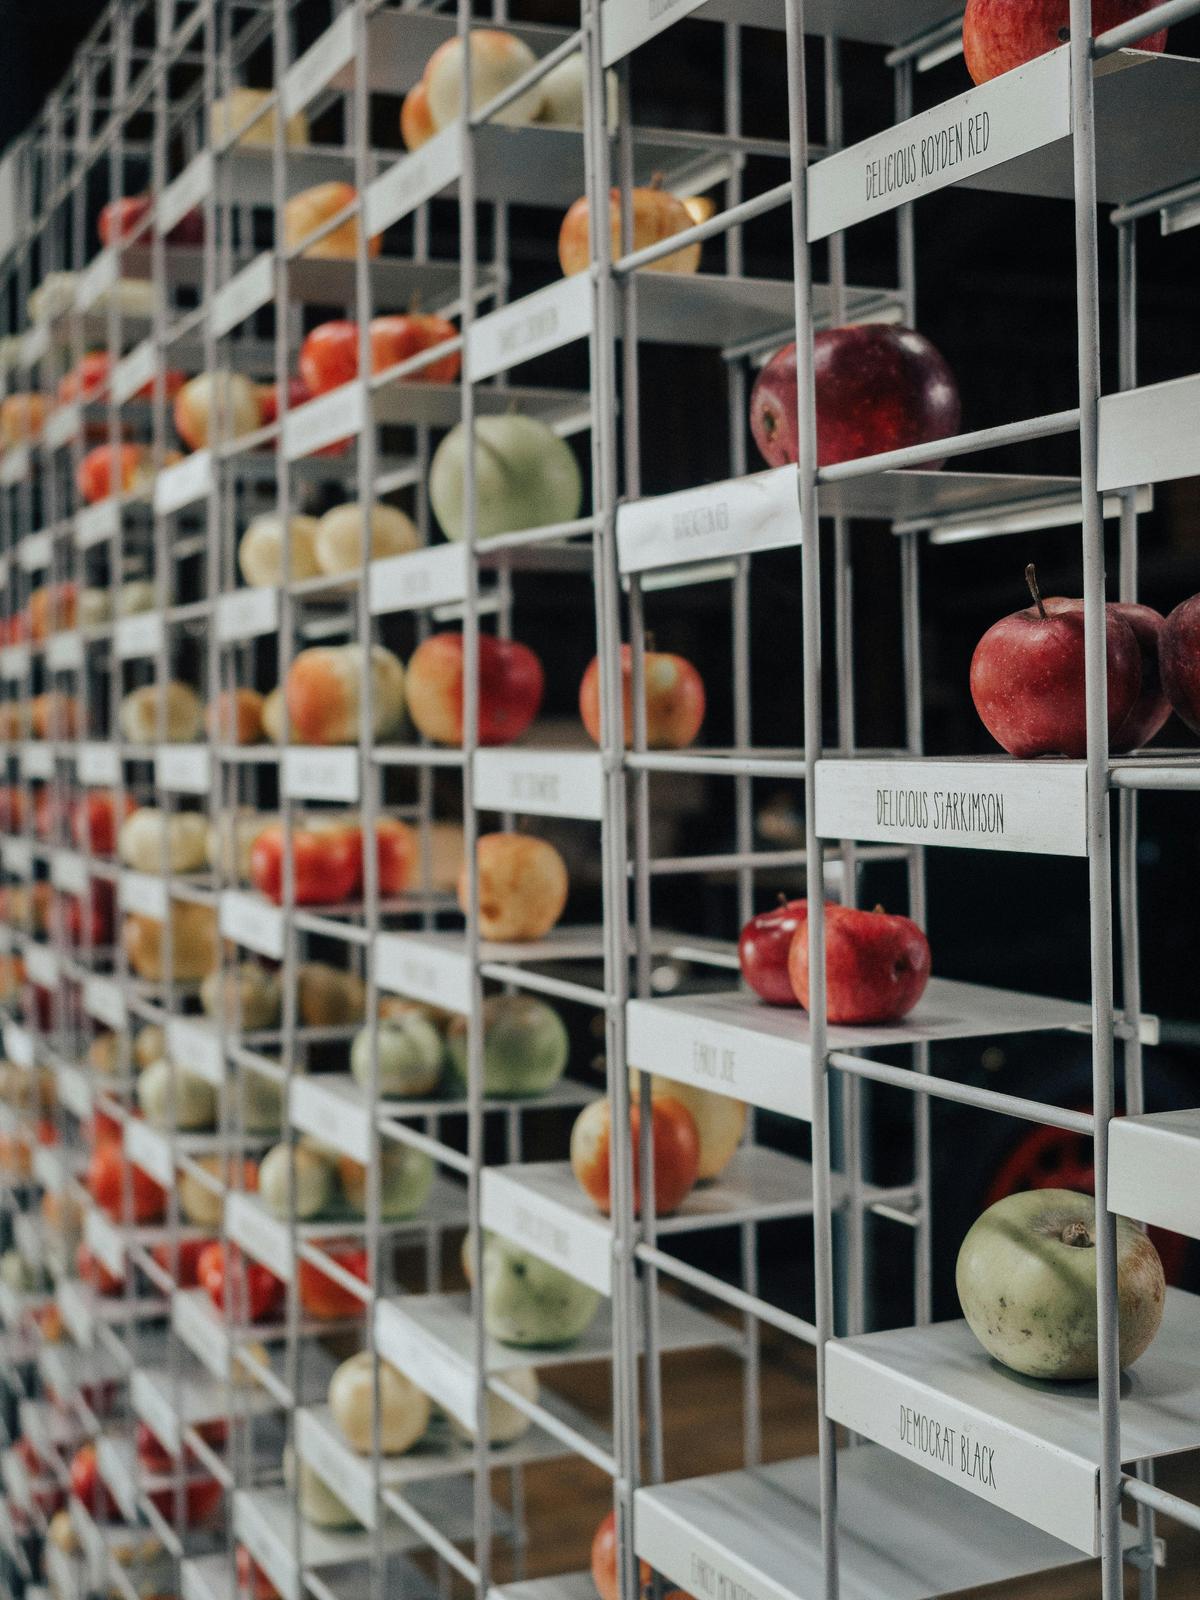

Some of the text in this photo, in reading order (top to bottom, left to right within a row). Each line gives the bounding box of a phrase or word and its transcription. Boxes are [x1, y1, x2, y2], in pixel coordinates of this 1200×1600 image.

[866, 112, 989, 201] DELICIOUS ROYDEN RED
[876, 789, 1004, 834] DELICIOUS STARKIMSON
[900, 1405, 996, 1489] DEMOCRAT BLACK
